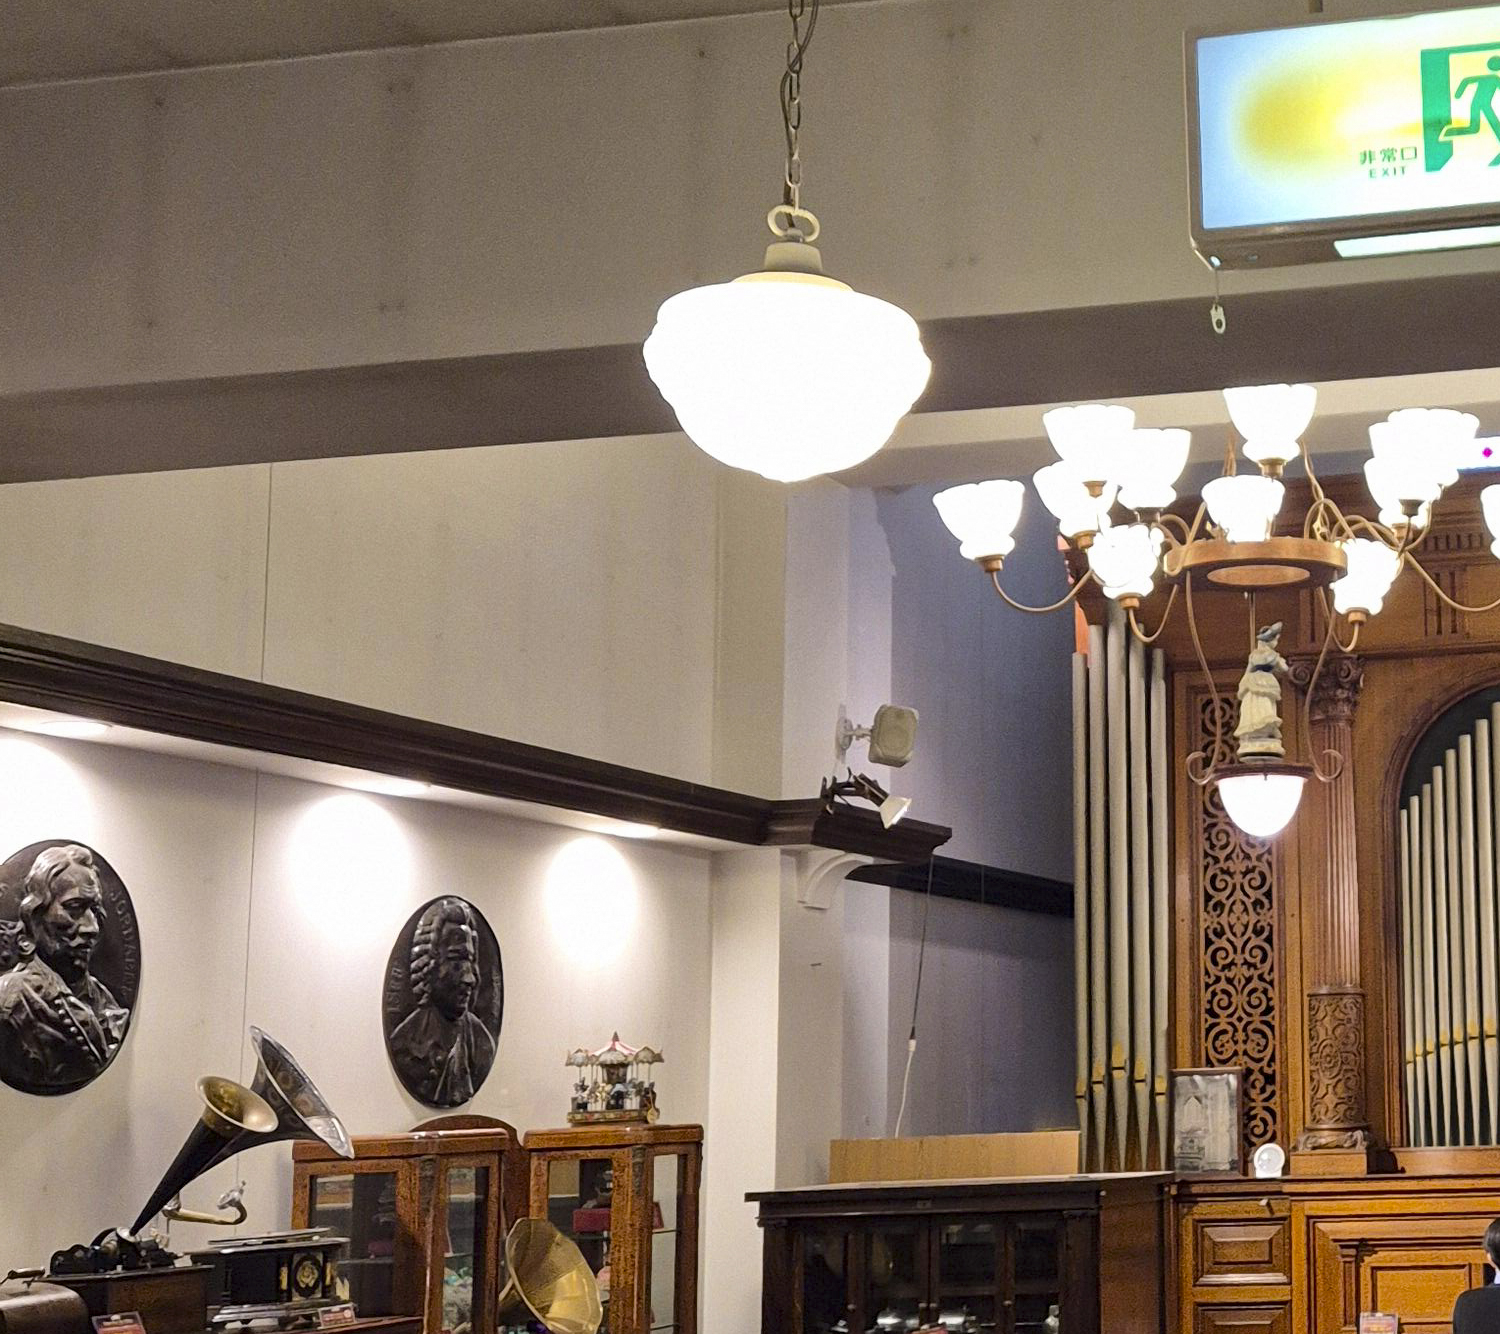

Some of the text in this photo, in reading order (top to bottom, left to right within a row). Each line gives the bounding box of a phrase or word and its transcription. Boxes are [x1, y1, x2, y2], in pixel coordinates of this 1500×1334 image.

[1359, 147, 1418, 165] 非常口
[1369, 165, 1406, 178] EXIT
